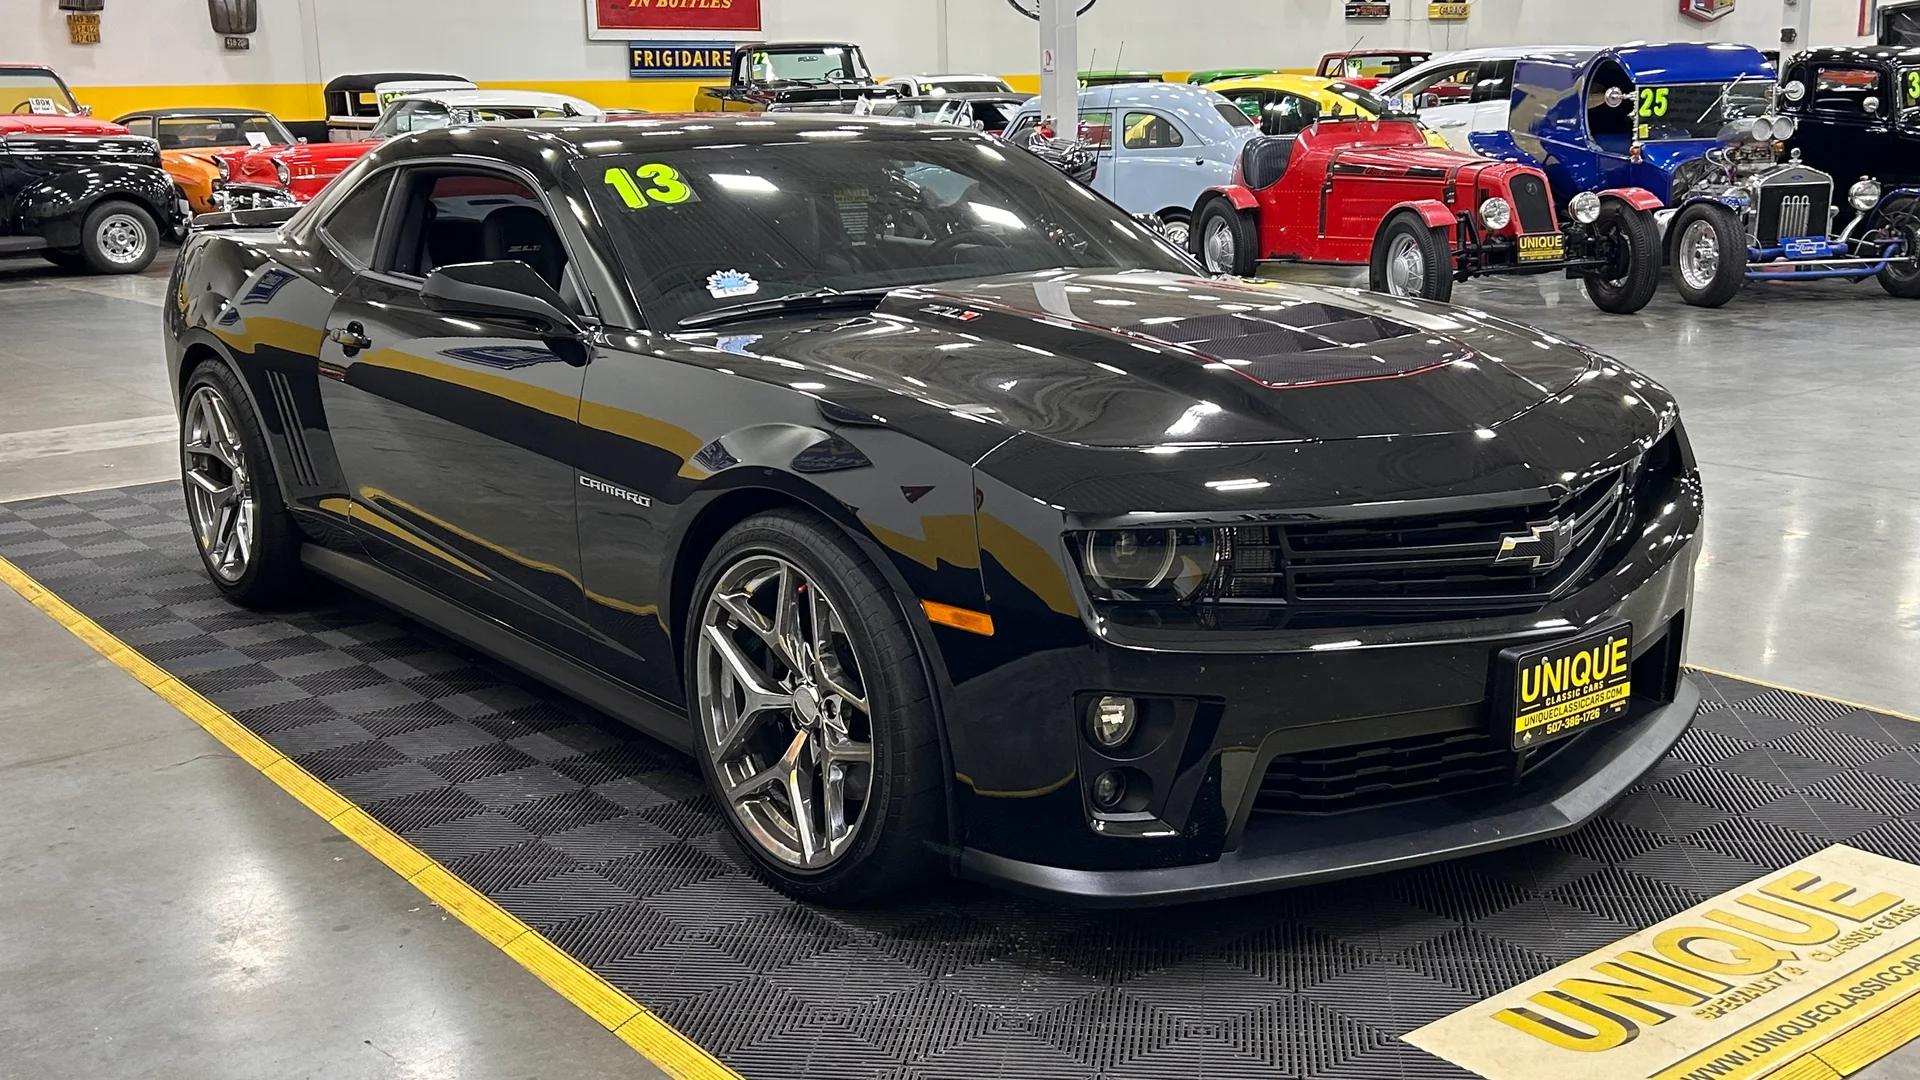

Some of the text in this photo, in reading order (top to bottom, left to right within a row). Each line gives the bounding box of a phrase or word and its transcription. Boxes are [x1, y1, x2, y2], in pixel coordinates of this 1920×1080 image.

[634, 50, 732, 67] FRIGIDAIRE
[1639, 88, 1669, 117] 25
[604, 163, 691, 209] 13
[1519, 235, 1563, 249] UNIQUE
[579, 475, 651, 508] CAMARO
[1521, 638, 1628, 703] UNIQUE
[1524, 687, 1623, 727] UNIQUECLASSICCARS.COM
[1545, 680, 1604, 707] CLASSIC CARS
[1546, 708, 1600, 735] 507-386-1726
[1489, 869, 1906, 1053] UNIQUE
[1693, 970, 1791, 1021] SPECIALTY
[1808, 924, 1883, 963] CLASSIC
